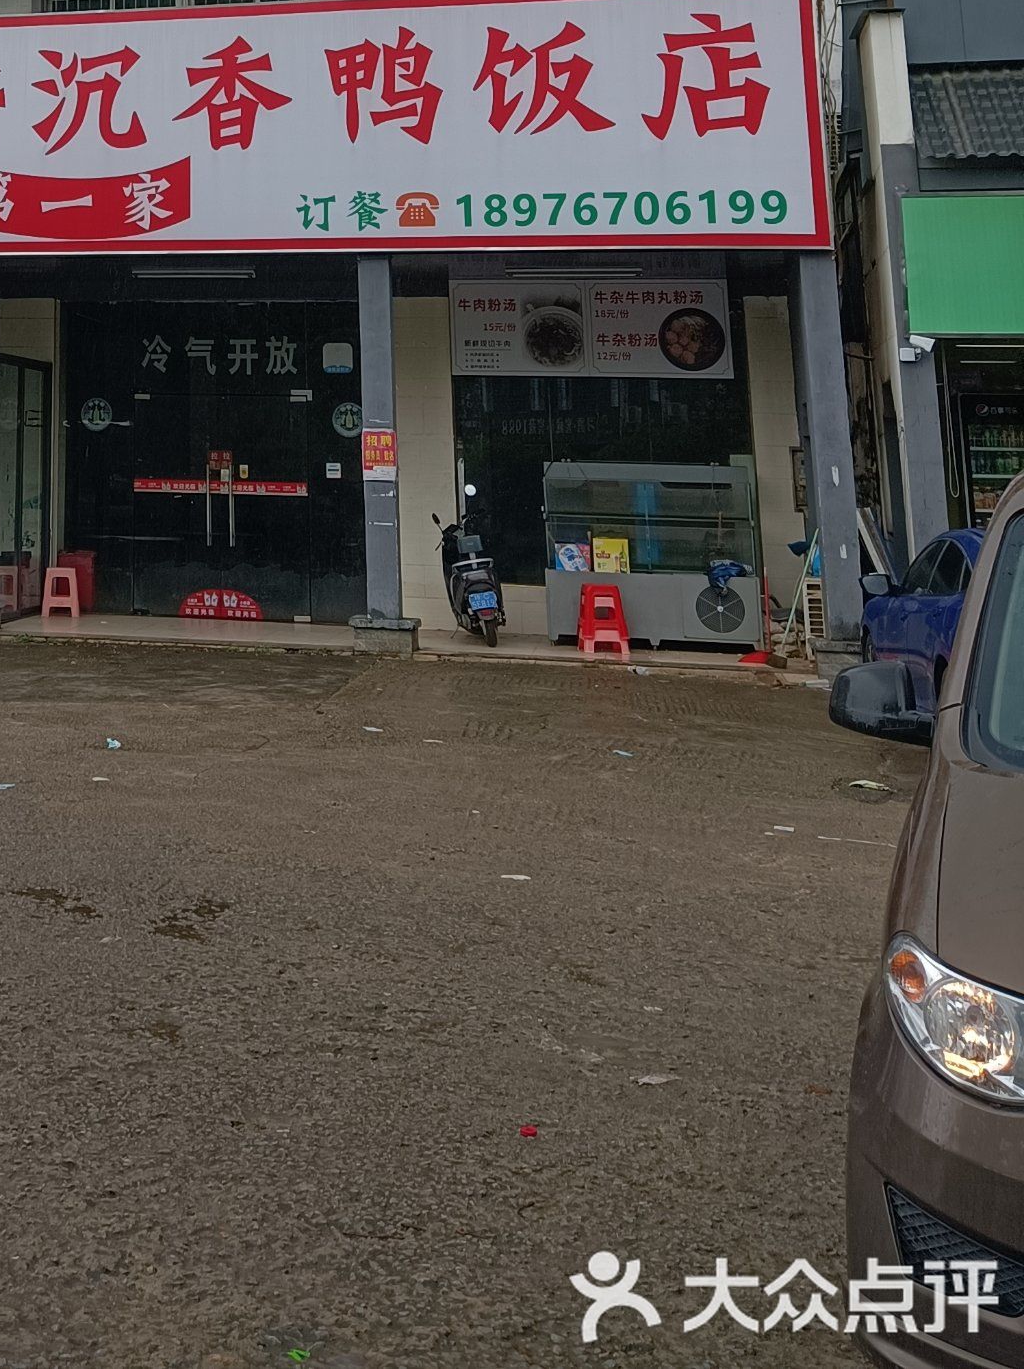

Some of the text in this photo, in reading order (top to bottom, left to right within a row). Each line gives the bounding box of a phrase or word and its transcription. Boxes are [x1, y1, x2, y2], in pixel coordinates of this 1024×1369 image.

[296, 189, 789, 232] 订餐 18976706199
[594, 290, 703, 304] 牛杂牛肉丸粉汤
[458, 298, 516, 311] 牛肉粉汤
[595, 309, 630, 319] 18元/份
[483, 322, 516, 332] 15元/份
[596, 333, 658, 347] 牛杂粉汤
[141, 334, 298, 375] 冷气开放
[597, 352, 631, 361] 12元/份
